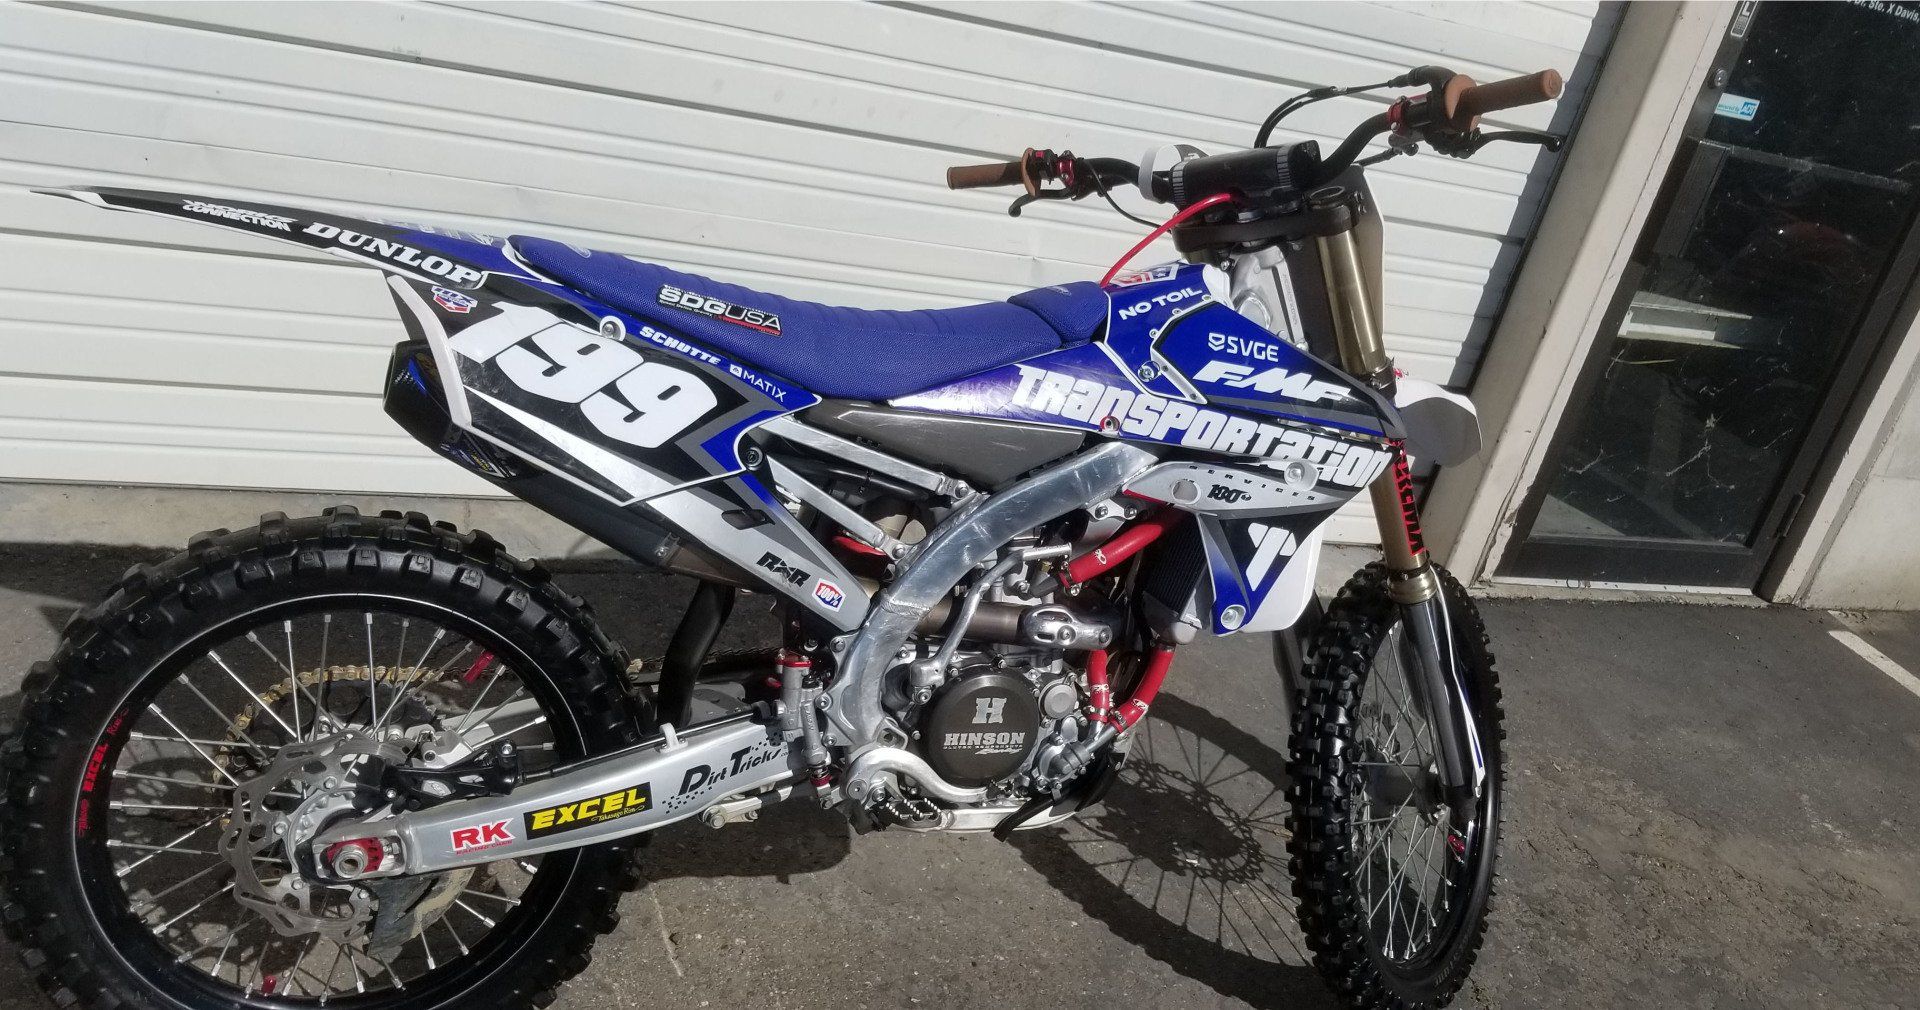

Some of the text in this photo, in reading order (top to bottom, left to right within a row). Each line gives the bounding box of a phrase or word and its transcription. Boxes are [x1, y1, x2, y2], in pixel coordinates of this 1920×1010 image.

[1886, 2, 1896, 15] X
[183, 205, 292, 232] CONNECTION
[302, 221, 483, 283] DUNLOP
[1118, 287, 1203, 321] NO TOIL
[449, 301, 718, 449] 199
[639, 326, 787, 403] SCHUTTE MATIX
[1193, 360, 1352, 403] FMF
[817, 585, 843, 607] 100%
[971, 697, 1008, 724] H
[943, 732, 1026, 746] HINSON
[678, 745, 782, 797] Dirt Tricks
[531, 788, 646, 831] EXCEL
[451, 819, 513, 850] RK
